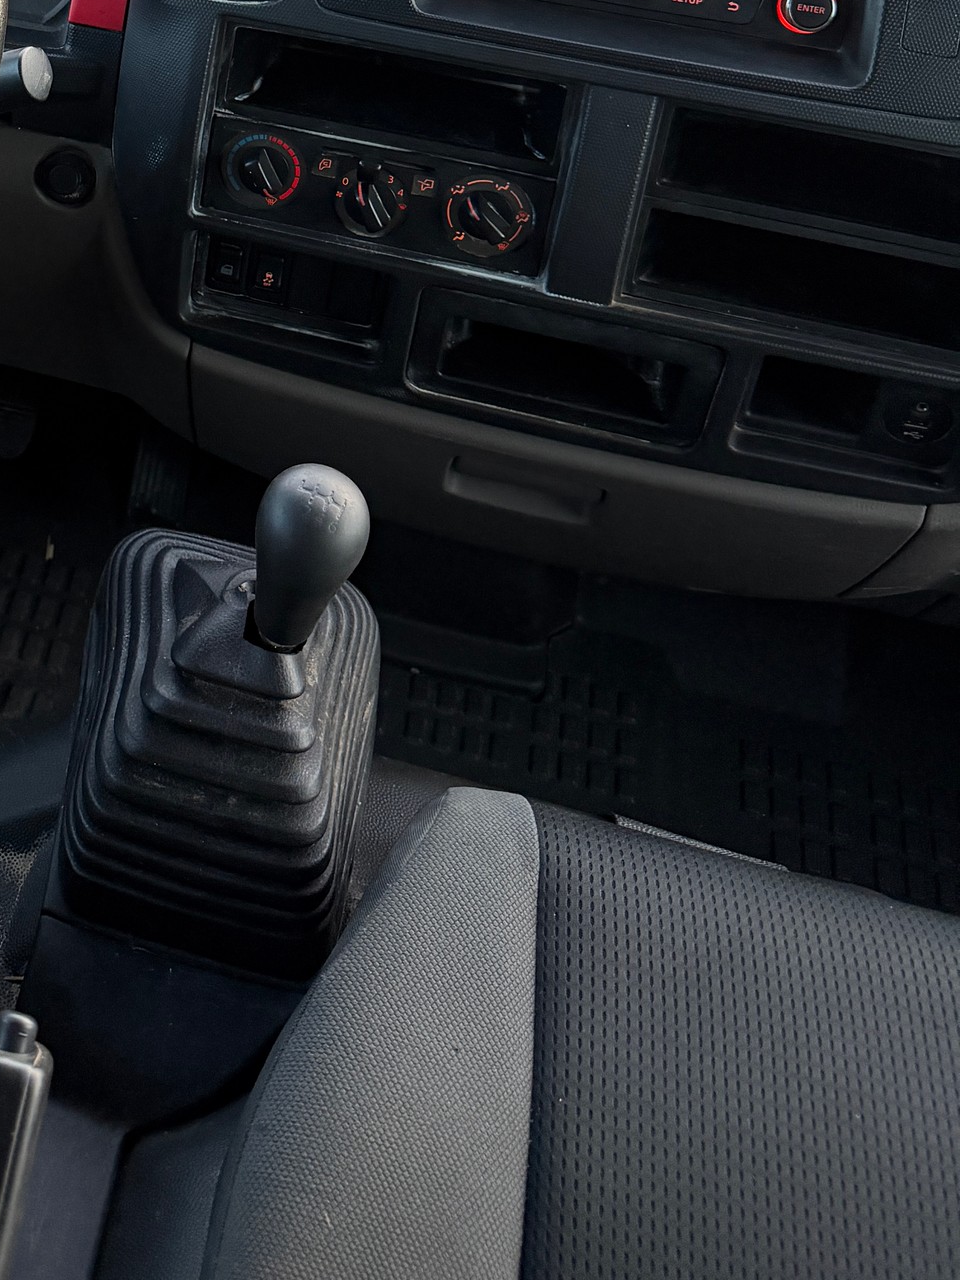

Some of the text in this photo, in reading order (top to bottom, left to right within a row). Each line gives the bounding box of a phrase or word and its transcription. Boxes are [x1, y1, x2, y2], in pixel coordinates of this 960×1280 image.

[797, 3, 826, 15] ENTER
[342, 177, 349, 186] 0
[388, 175, 394, 184] 3
[397, 188, 404, 197] 4
